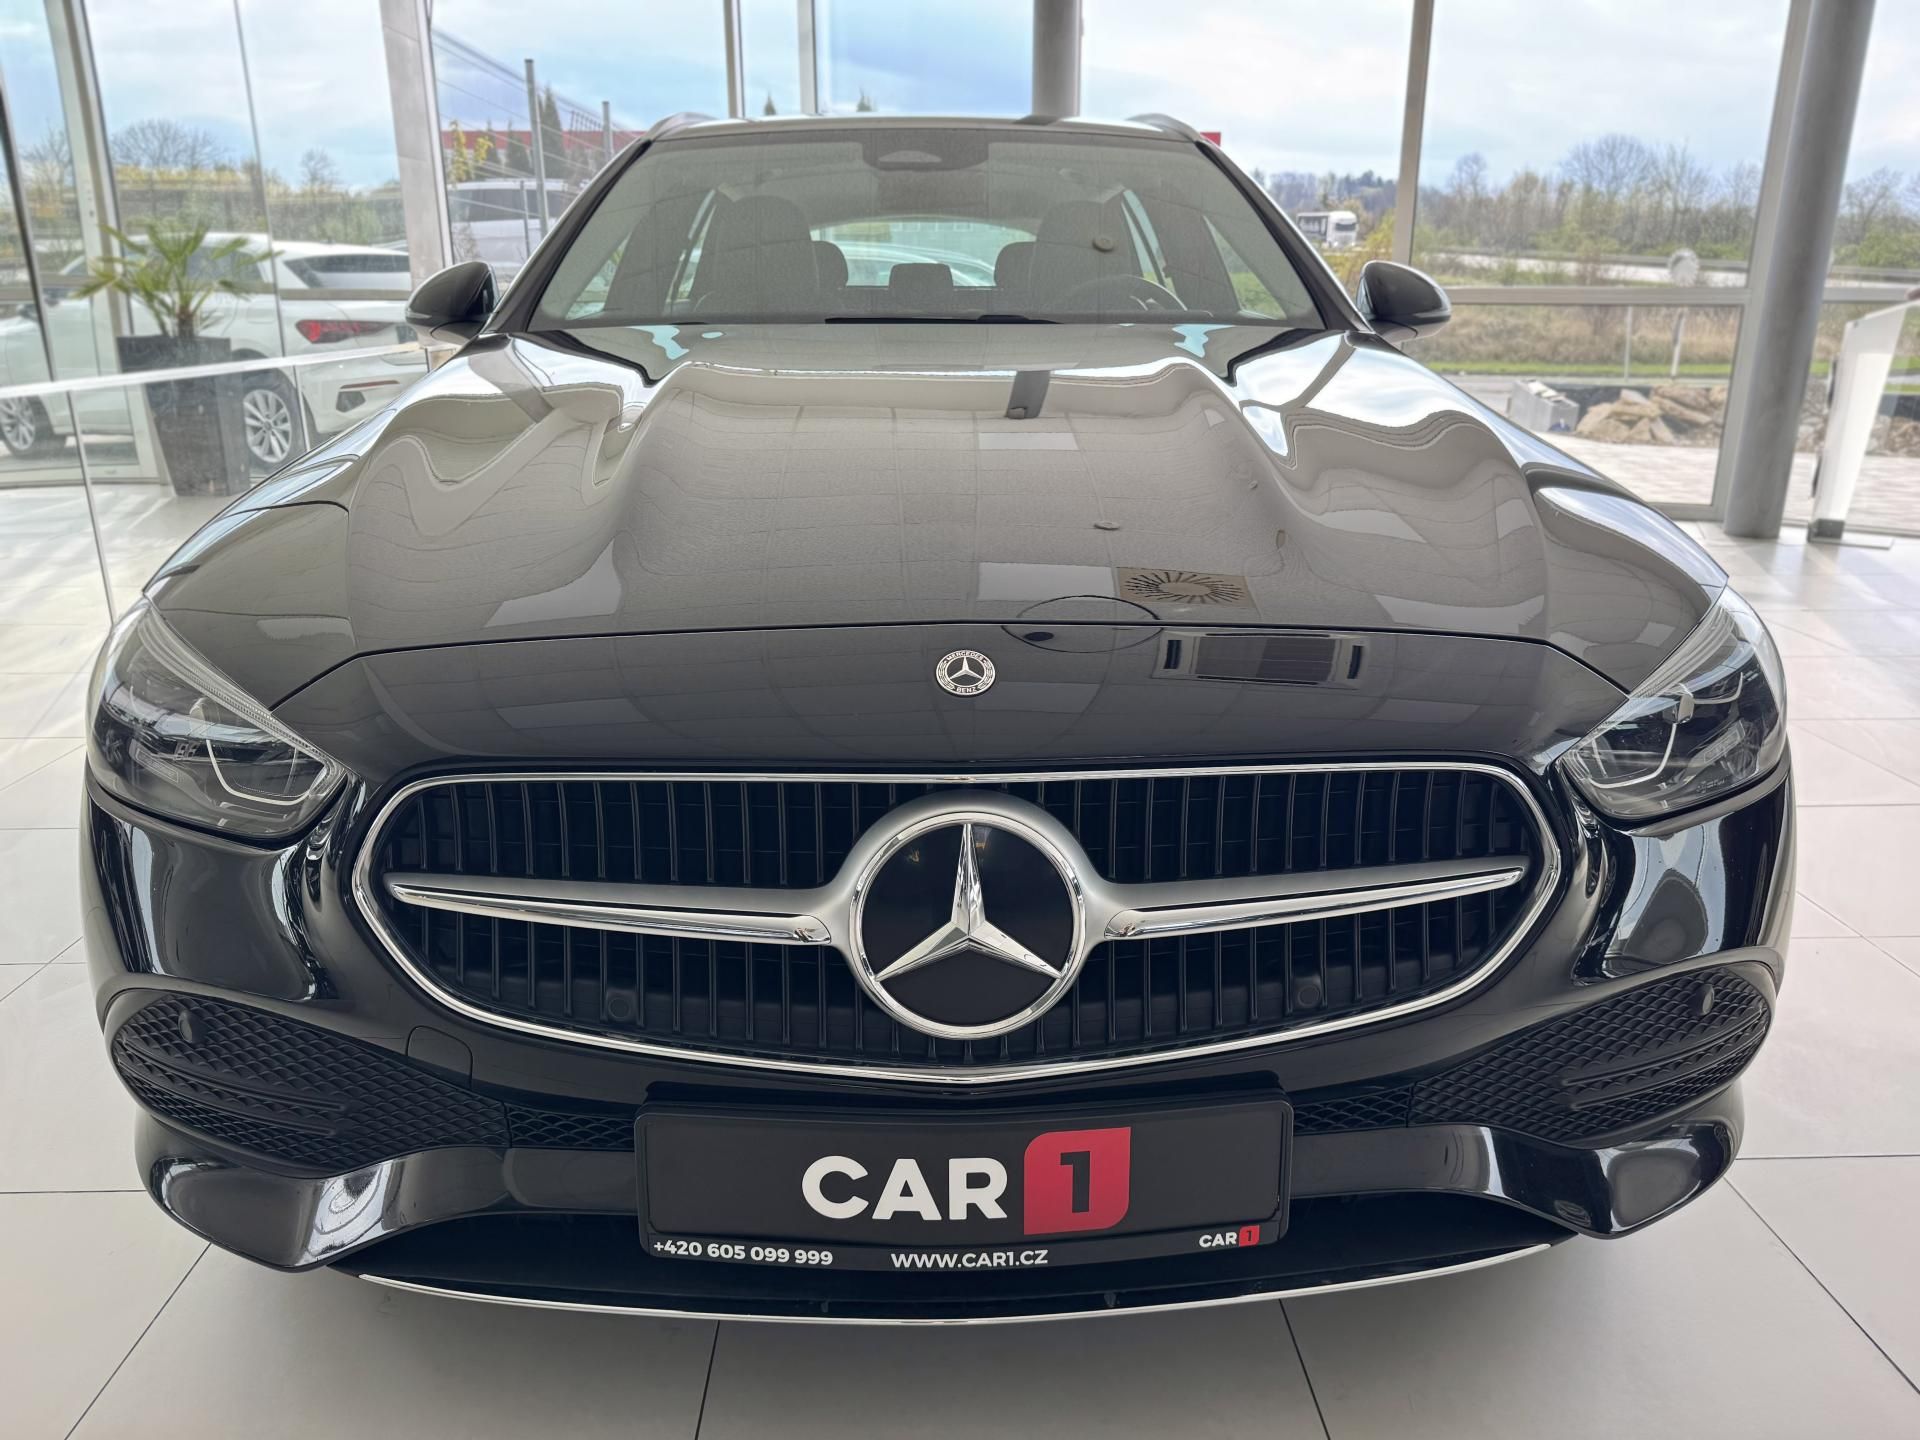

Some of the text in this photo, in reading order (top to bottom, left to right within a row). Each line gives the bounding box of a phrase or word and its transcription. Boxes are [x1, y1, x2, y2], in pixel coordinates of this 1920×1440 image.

[802, 1155, 1008, 1221] CAR
[653, 1239, 833, 1266] +420 605 099 999
[890, 1249, 1049, 1268] WWW.CAR1.CZ
